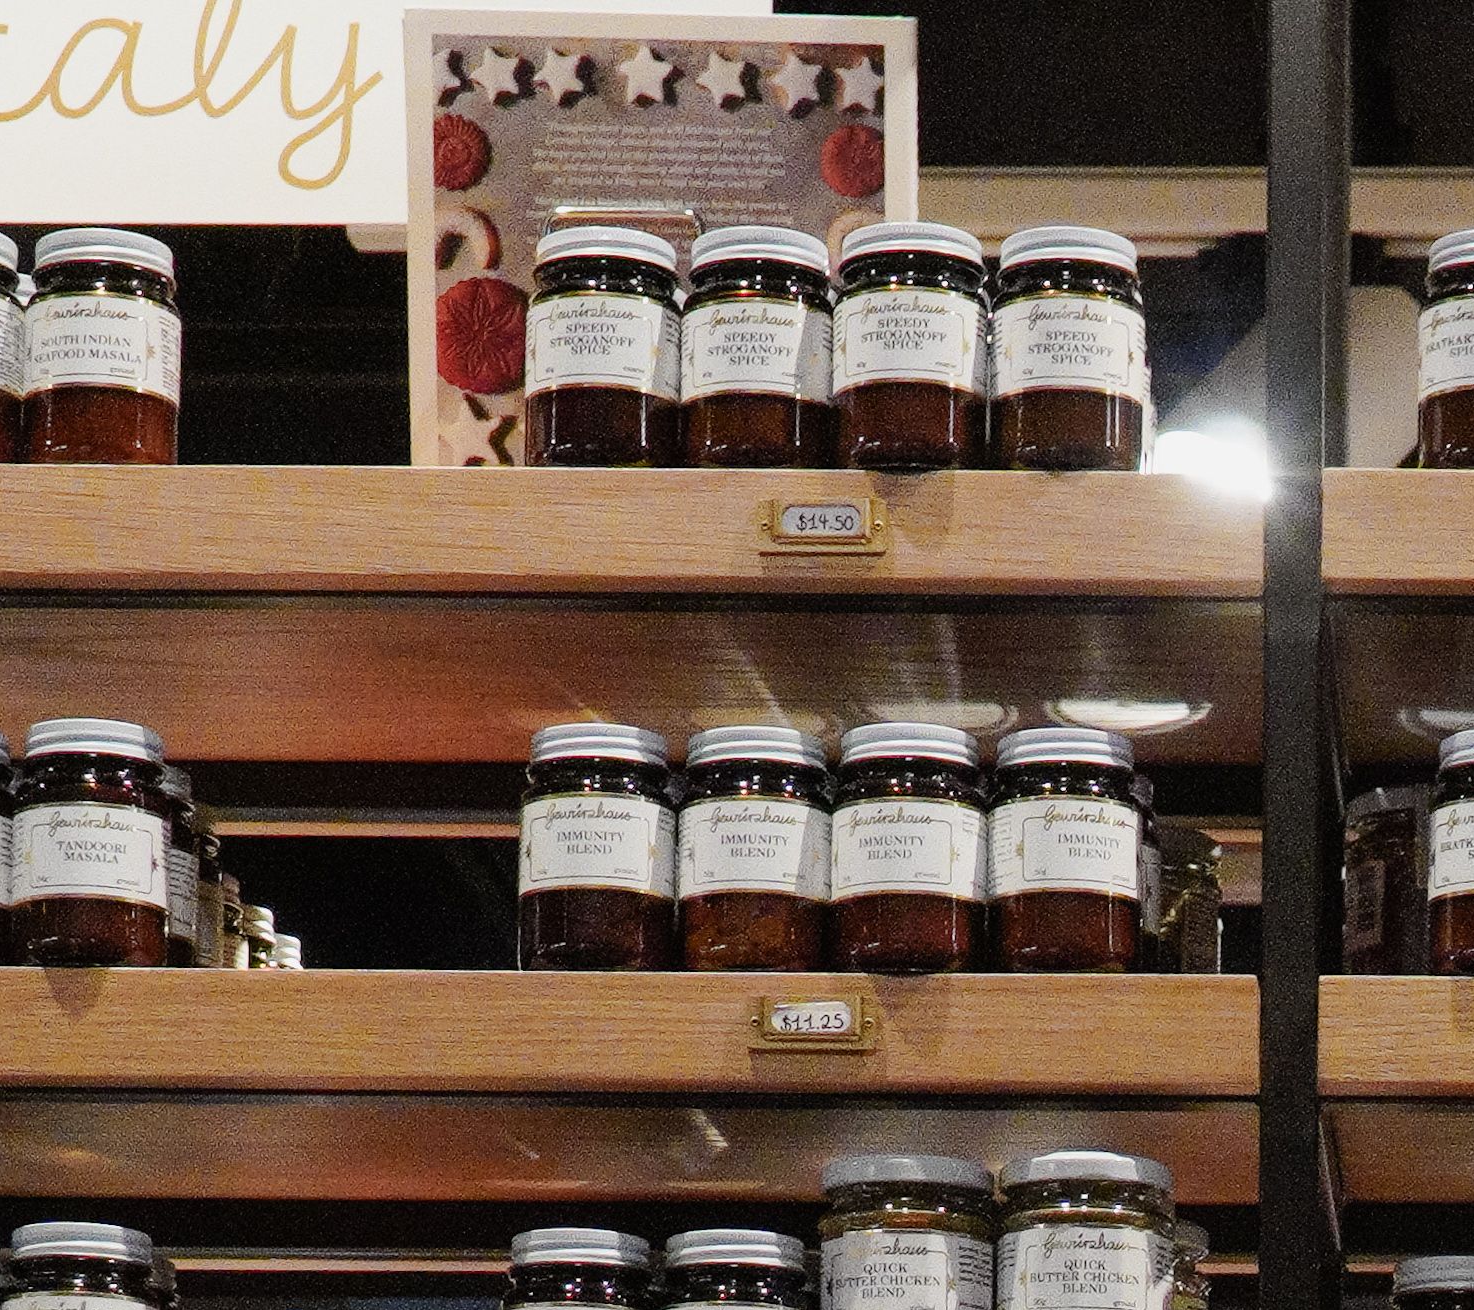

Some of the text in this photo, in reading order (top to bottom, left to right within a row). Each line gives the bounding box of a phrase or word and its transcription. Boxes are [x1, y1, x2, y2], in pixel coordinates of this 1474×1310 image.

[564, 322, 618, 334] SPEEDY
[41, 335, 131, 349] SOUTH INDIAN
[549, 336, 637, 349] STROGANOFF
[33, 349, 142, 364] SEAFOOD MASALA
[570, 345, 612, 356] SPICE
[795, 512, 855, 532] $14.50
[719, 833, 790, 847] IMMUNITY
[858, 835, 926, 849] IMMUNITY
[729, 846, 777, 859] BLEND
[866, 847, 913, 861] BLEND
[780, 1013, 845, 1033] $11.25
[862, 1262, 908, 1274] QUICK
[1062, 1259, 1107, 1272] QUICK
[880, 1274, 941, 1289] CHICKEN
[1028, 1270, 1141, 1285] BUTTER CHICKEN
[860, 1286, 905, 1299] BLEND
[1061, 1282, 1107, 1295] BLEND
